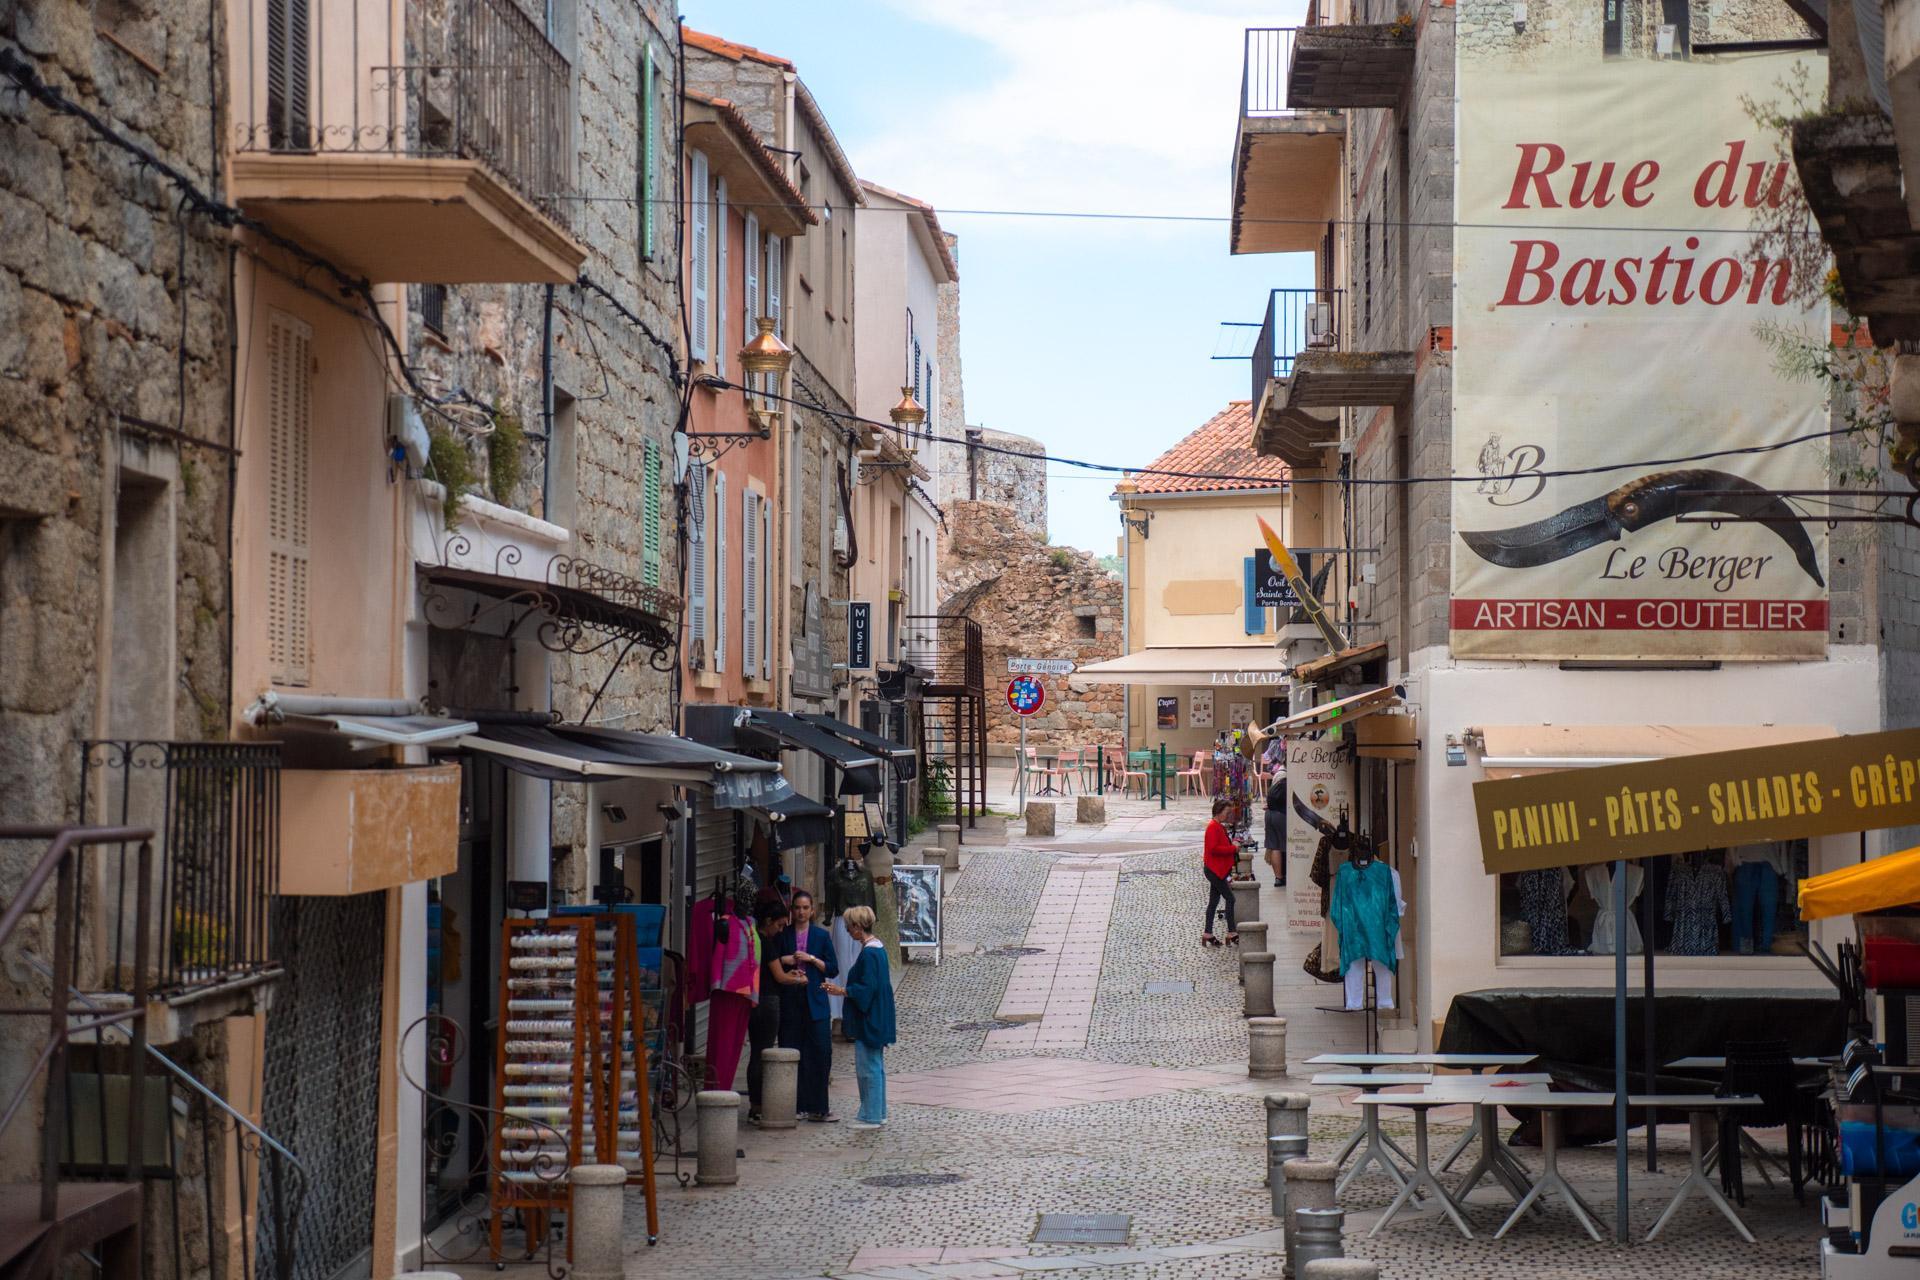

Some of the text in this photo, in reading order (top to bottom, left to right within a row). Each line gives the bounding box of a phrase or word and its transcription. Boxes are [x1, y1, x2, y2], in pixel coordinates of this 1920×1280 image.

[1501, 139, 1791, 209] Rue du
[1496, 236, 1793, 306] Bastion
[1599, 546, 1773, 593] Le Berger
[855, 608, 865, 664] MUSÉE
[1473, 602, 1605, 628] ARTISAN
[1636, 601, 1806, 629] COUTELIER
[1010, 662, 1032, 671] Porte
[1211, 672, 1229, 684] LA
[1291, 747, 1307, 763] Le
[1493, 800, 1580, 850] PANINI
[1605, 785, 1682, 838] PÂTES
[1708, 770, 1823, 825] SALADES
[1850, 753, 1920, 808] CRÊP
